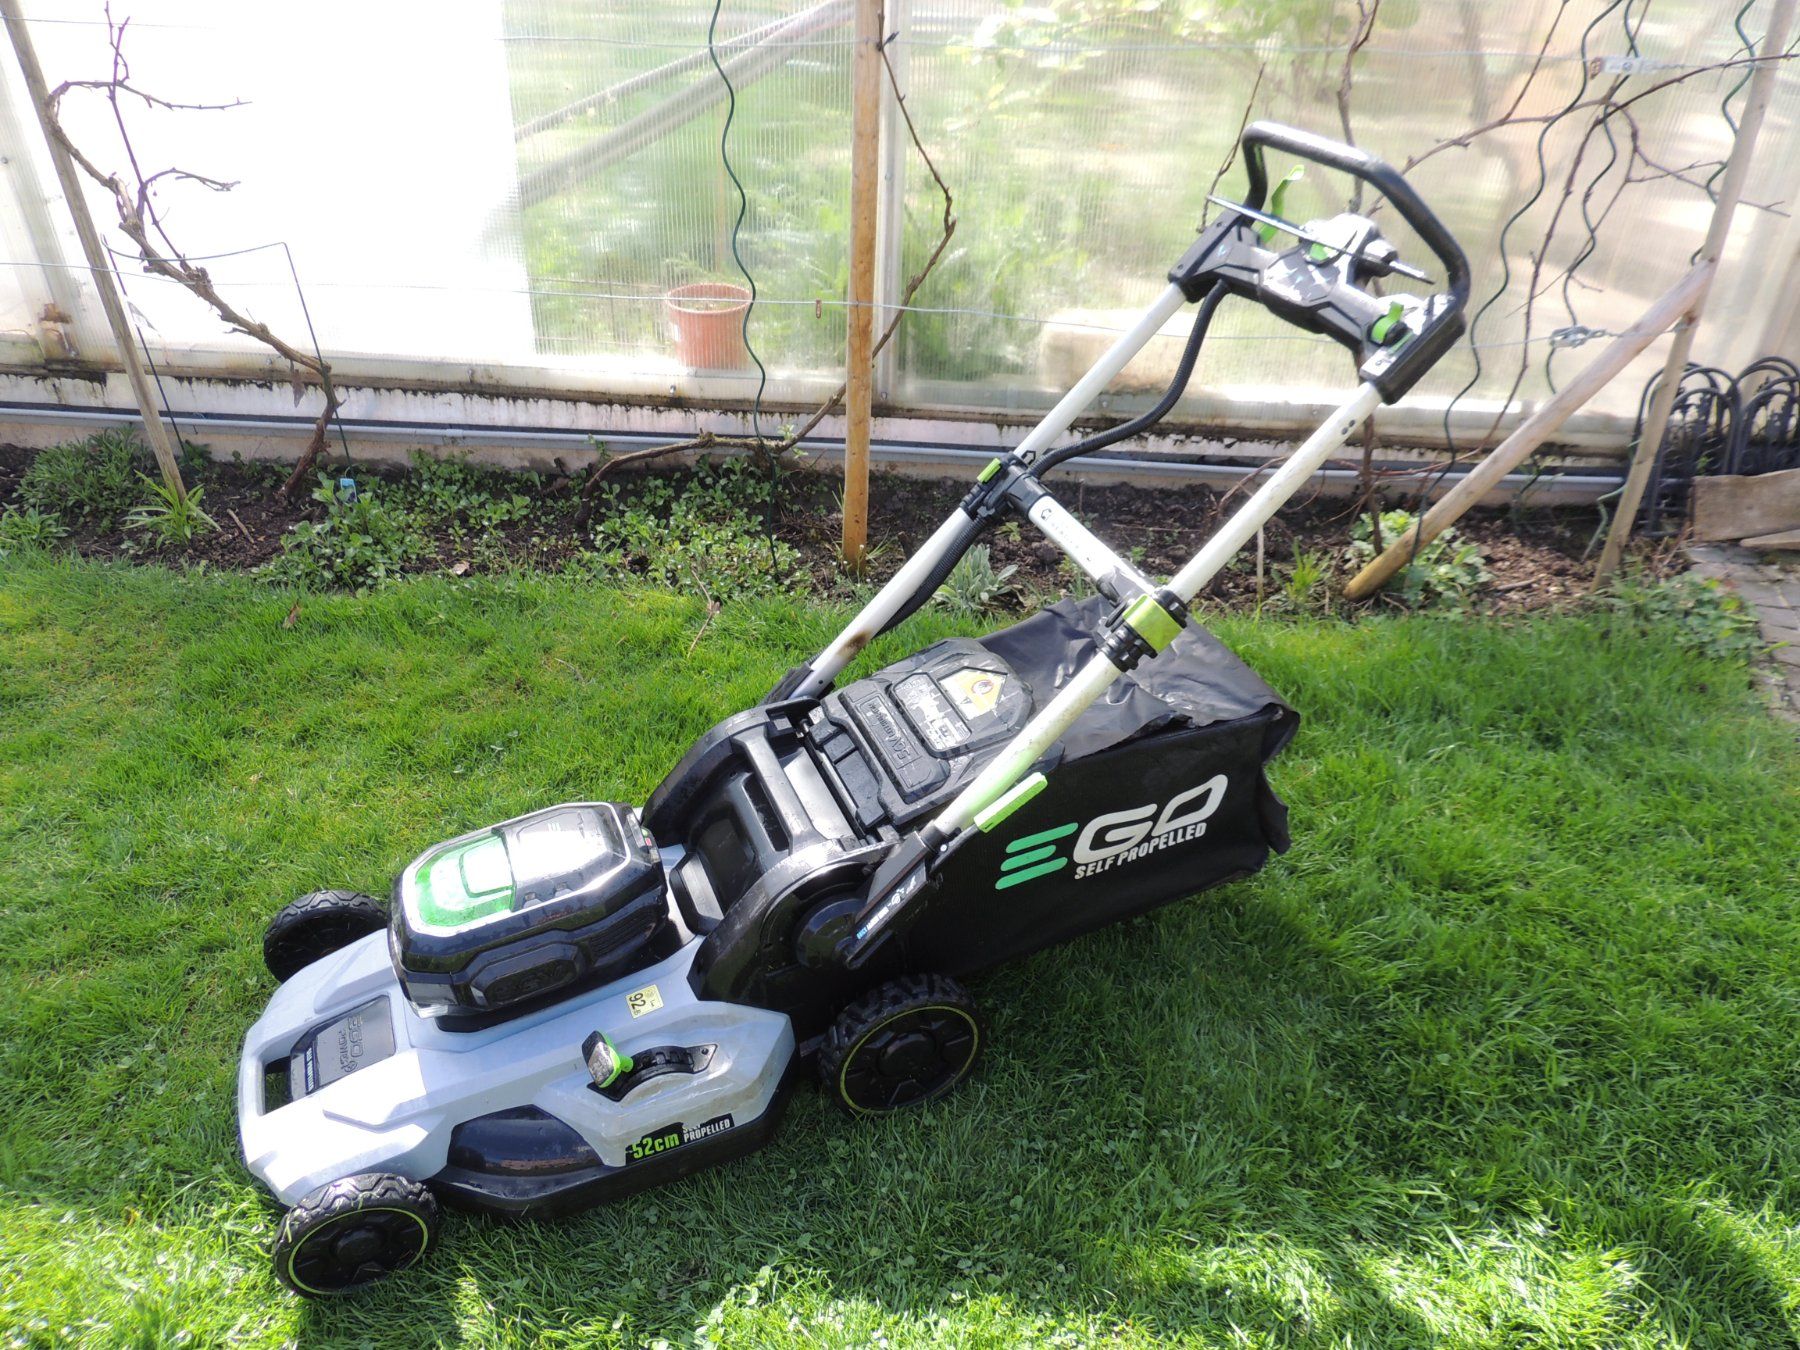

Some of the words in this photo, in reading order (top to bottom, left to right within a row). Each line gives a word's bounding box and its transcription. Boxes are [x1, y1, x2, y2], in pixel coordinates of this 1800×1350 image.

[995, 774, 1229, 890] EGO
[1074, 854, 1116, 880] SELF
[1116, 822, 1208, 867] PROPELLED
[628, 992, 647, 1010] 92
[683, 1118, 731, 1143] PROPELLED
[631, 1132, 680, 1160] 52cm
